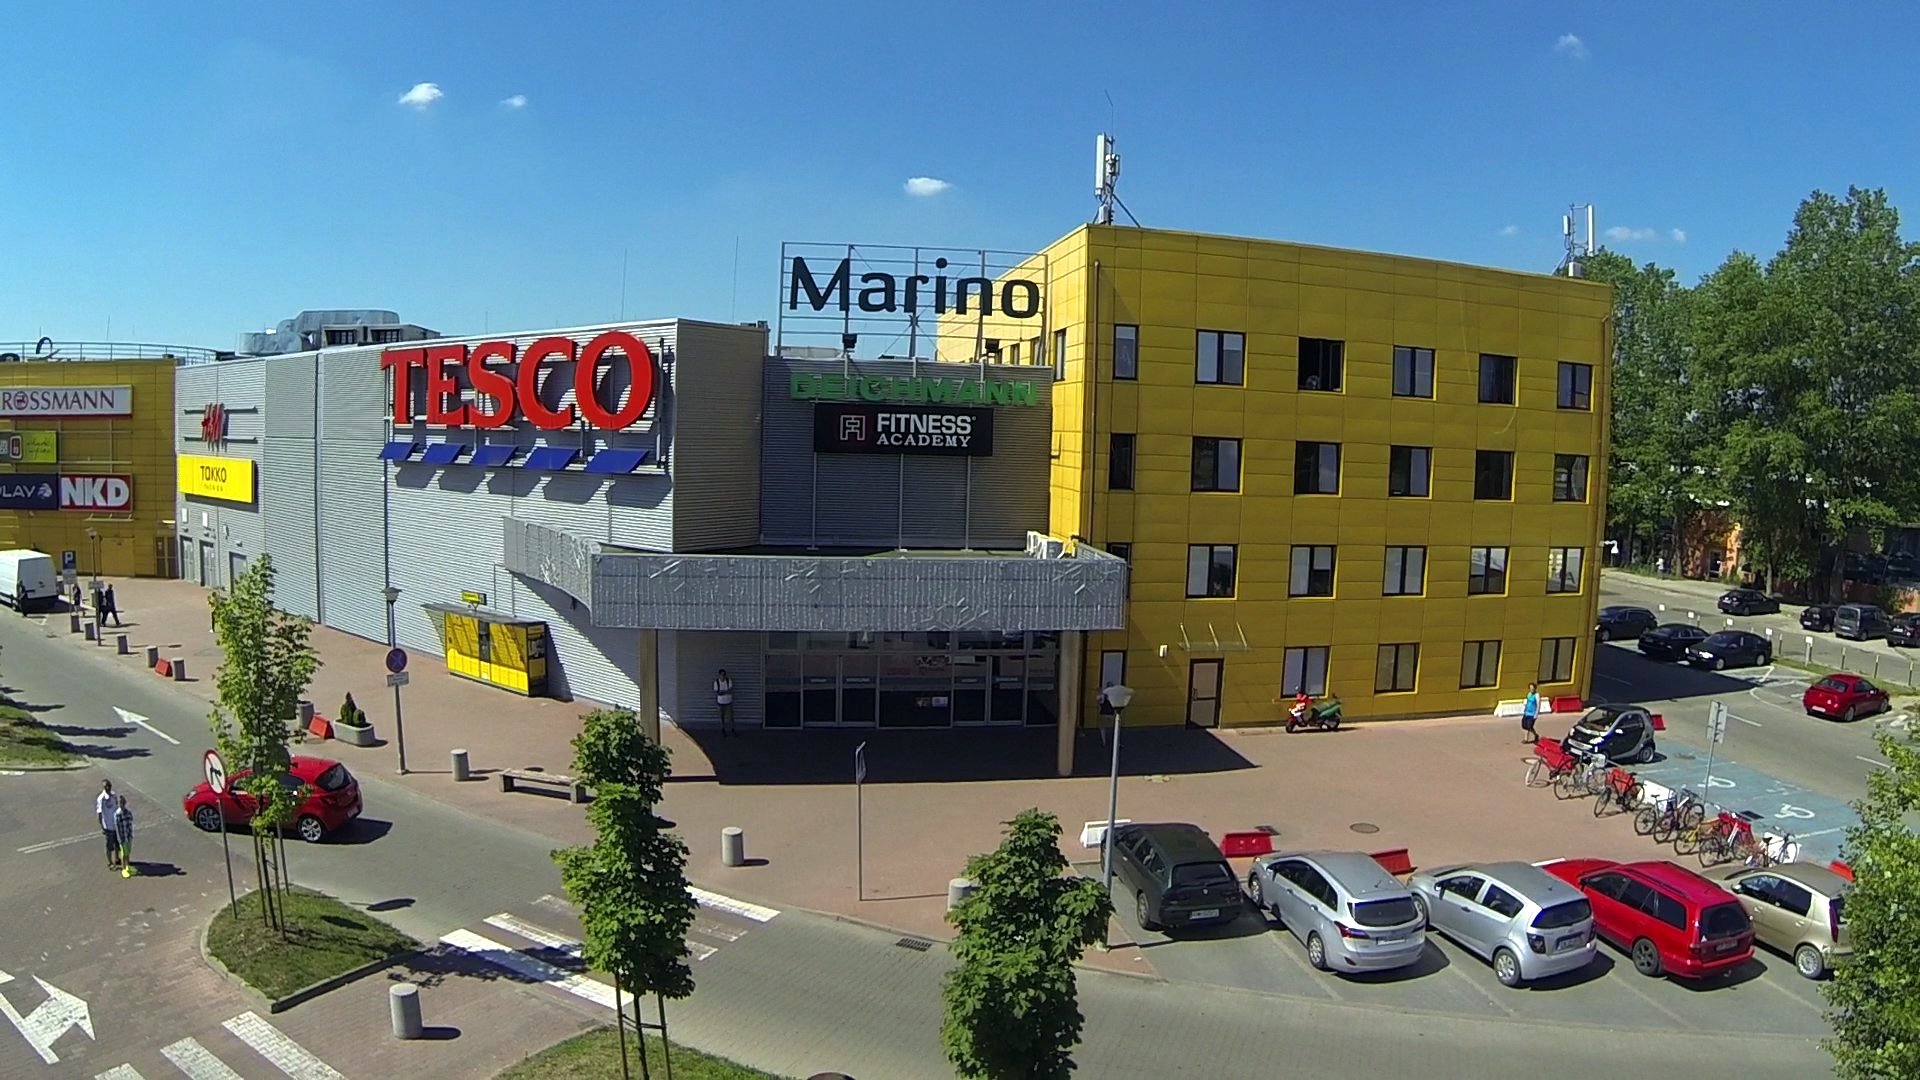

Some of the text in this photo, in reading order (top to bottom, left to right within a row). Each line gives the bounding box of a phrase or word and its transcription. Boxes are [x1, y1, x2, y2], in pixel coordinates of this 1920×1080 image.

[789, 256, 1040, 318] Marino
[381, 330, 656, 431] TESCO
[790, 371, 1039, 407] DEICHMANN
[2, 390, 115, 411] ROSSMANN
[876, 413, 972, 435] FITNESS
[876, 433, 972, 448] ACADEMY
[0, 485, 36, 500] LAY
[61, 477, 130, 507] NKD
[64, 551, 74, 565] P
